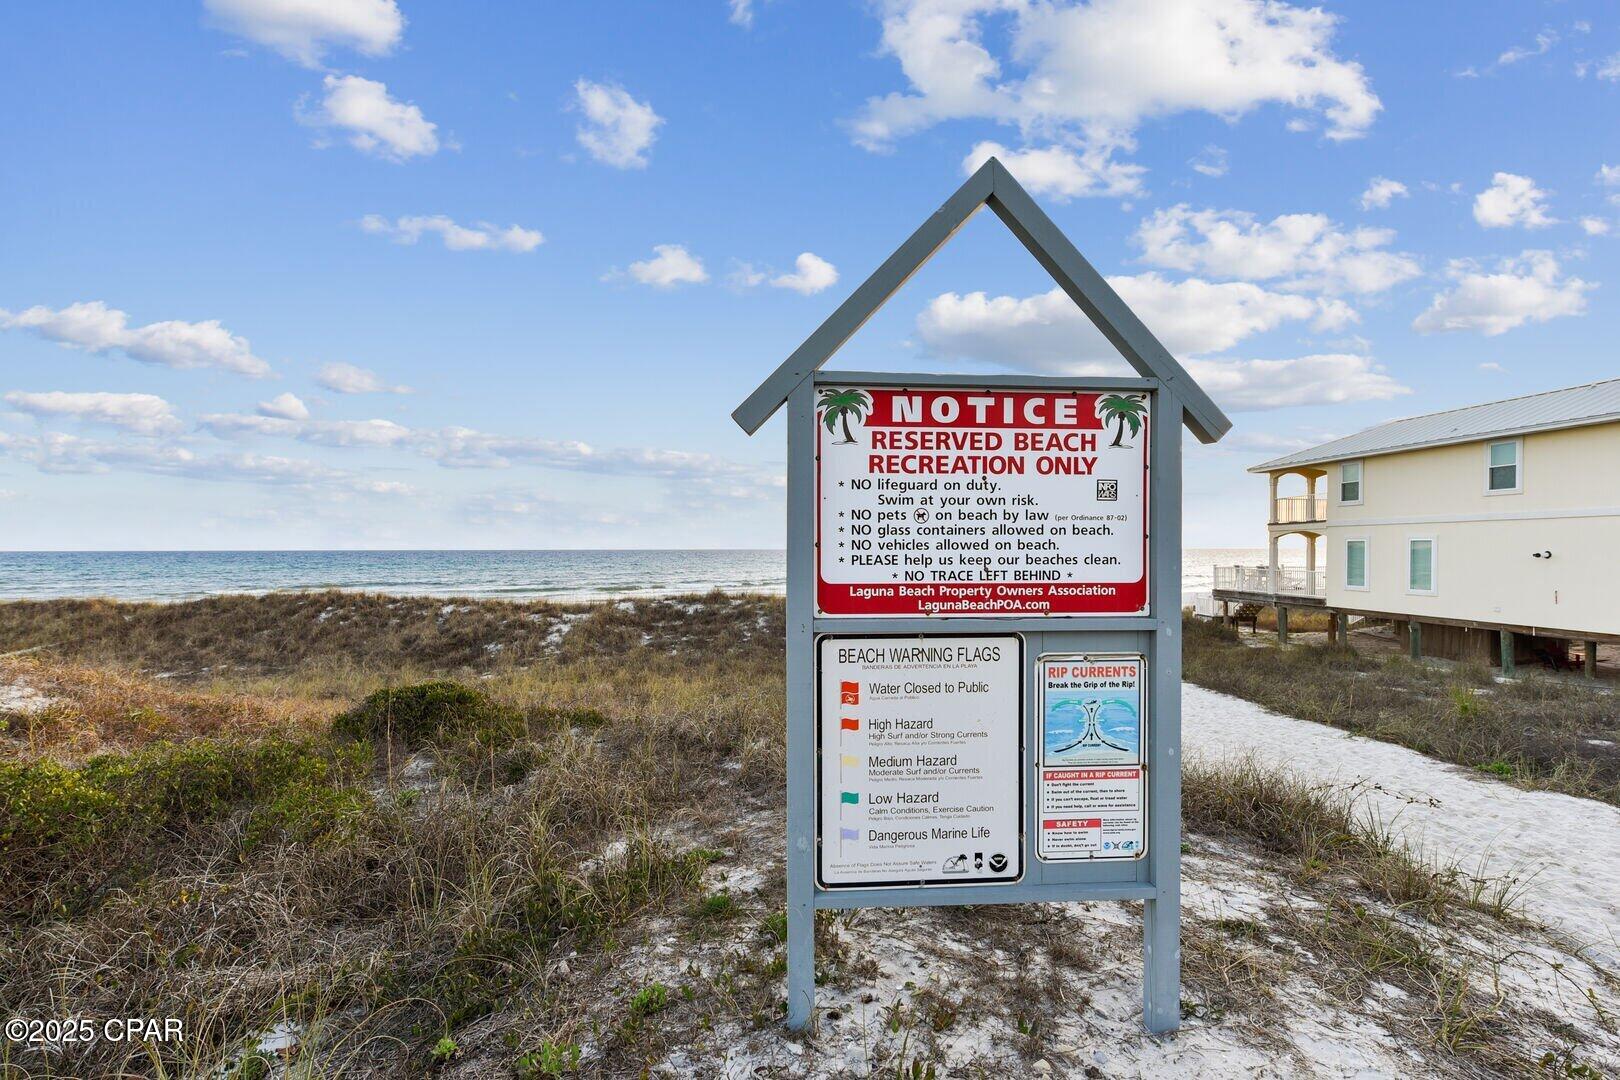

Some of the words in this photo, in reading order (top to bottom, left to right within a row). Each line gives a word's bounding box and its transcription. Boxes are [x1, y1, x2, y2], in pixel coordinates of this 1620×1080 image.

[892, 396, 1077, 425] NOTICE
[872, 430, 1003, 451] RESERVED
[1014, 432, 1096, 452] BEACH
[869, 454, 1024, 475] RECREATION
[1036, 456, 1098, 475] ONLY
[851, 479, 872, 490] NO
[877, 478, 938, 493] lifeguard
[944, 481, 961, 490] on
[966, 478, 1001, 493] duty.
[1098, 482, 1117, 491] INFO
[878, 494, 914, 506] Swim
[920, 495, 934, 506] at
[940, 497, 971, 508] your
[976, 497, 1006, 506] own
[1012, 494, 1039, 506] risk.
[851, 509, 872, 520] NO
[878, 510, 907, 523] pets
[935, 511, 952, 521] on
[958, 509, 997, 521] beach
[1003, 509, 1019, 523] by
[1025, 509, 1049, 521] law
[1054, 514, 1068, 522] (per
[1106, 514, 1128, 522] 87-02)
[851, 524, 872, 536] NO
[878, 524, 911, 538] glass
[916, 524, 986, 536] containers
[992, 524, 1044, 536] allowed
[1050, 526, 1067, 536] on
[1072, 524, 1114, 536] beach.
[851, 539, 872, 551] NO
[878, 539, 930, 551] vehicles
[935, 539, 989, 551] allowed
[995, 541, 1012, 551] on
[1017, 539, 1060, 551] beach.
[851, 554, 899, 566] PLEASE
[904, 554, 933, 568] help
[939, 556, 953, 566] us
[959, 554, 992, 568] keep
[998, 556, 1020, 565] our
[1025, 553, 1078, 565] beaches
[1084, 553, 1121, 565] clean.
[904, 570, 924, 581] NO
[930, 570, 973, 581] TRACE
[979, 570, 1008, 581] LEFT
[1014, 570, 1061, 581] BEHIND
[849, 586, 894, 599] Laguna
[899, 585, 935, 597] Beach
[939, 586, 992, 598] Property
[996, 585, 1043, 596] Owners
[1048, 584, 1116, 596] Association
[918, 599, 1050, 612] LagunaBeachPOA.com
[838, 648, 885, 664] BEACH
[889, 647, 953, 663] WARNING
[957, 646, 1001, 662] FLAGS
[1048, 667, 1068, 678] RIP
[1072, 666, 1136, 678] CURRENTS
[869, 683, 900, 694] Water
[904, 682, 941, 694] Closed
[945, 683, 955, 693] to
[958, 681, 989, 693] Public
[1084, 682, 1098, 690] Grip
[1122, 681, 1136, 689] Rip!
[868, 718, 892, 733] High
[895, 718, 933, 730] Hazard
[868, 732, 885, 742] High
[888, 732, 902, 740] Surf
[904, 732, 928, 740] and/or
[930, 732, 954, 740] Strong
[868, 756, 913, 767] Medium
[916, 755, 957, 766] Hazard
[868, 768, 904, 776] Moderate
[868, 793, 892, 805] Low
[896, 792, 939, 804] Hazard
[890, 806, 930, 815] Conditions,
[868, 829, 928, 844] Dangerous
[931, 828, 968, 839] Marine
[971, 826, 990, 838] Life
